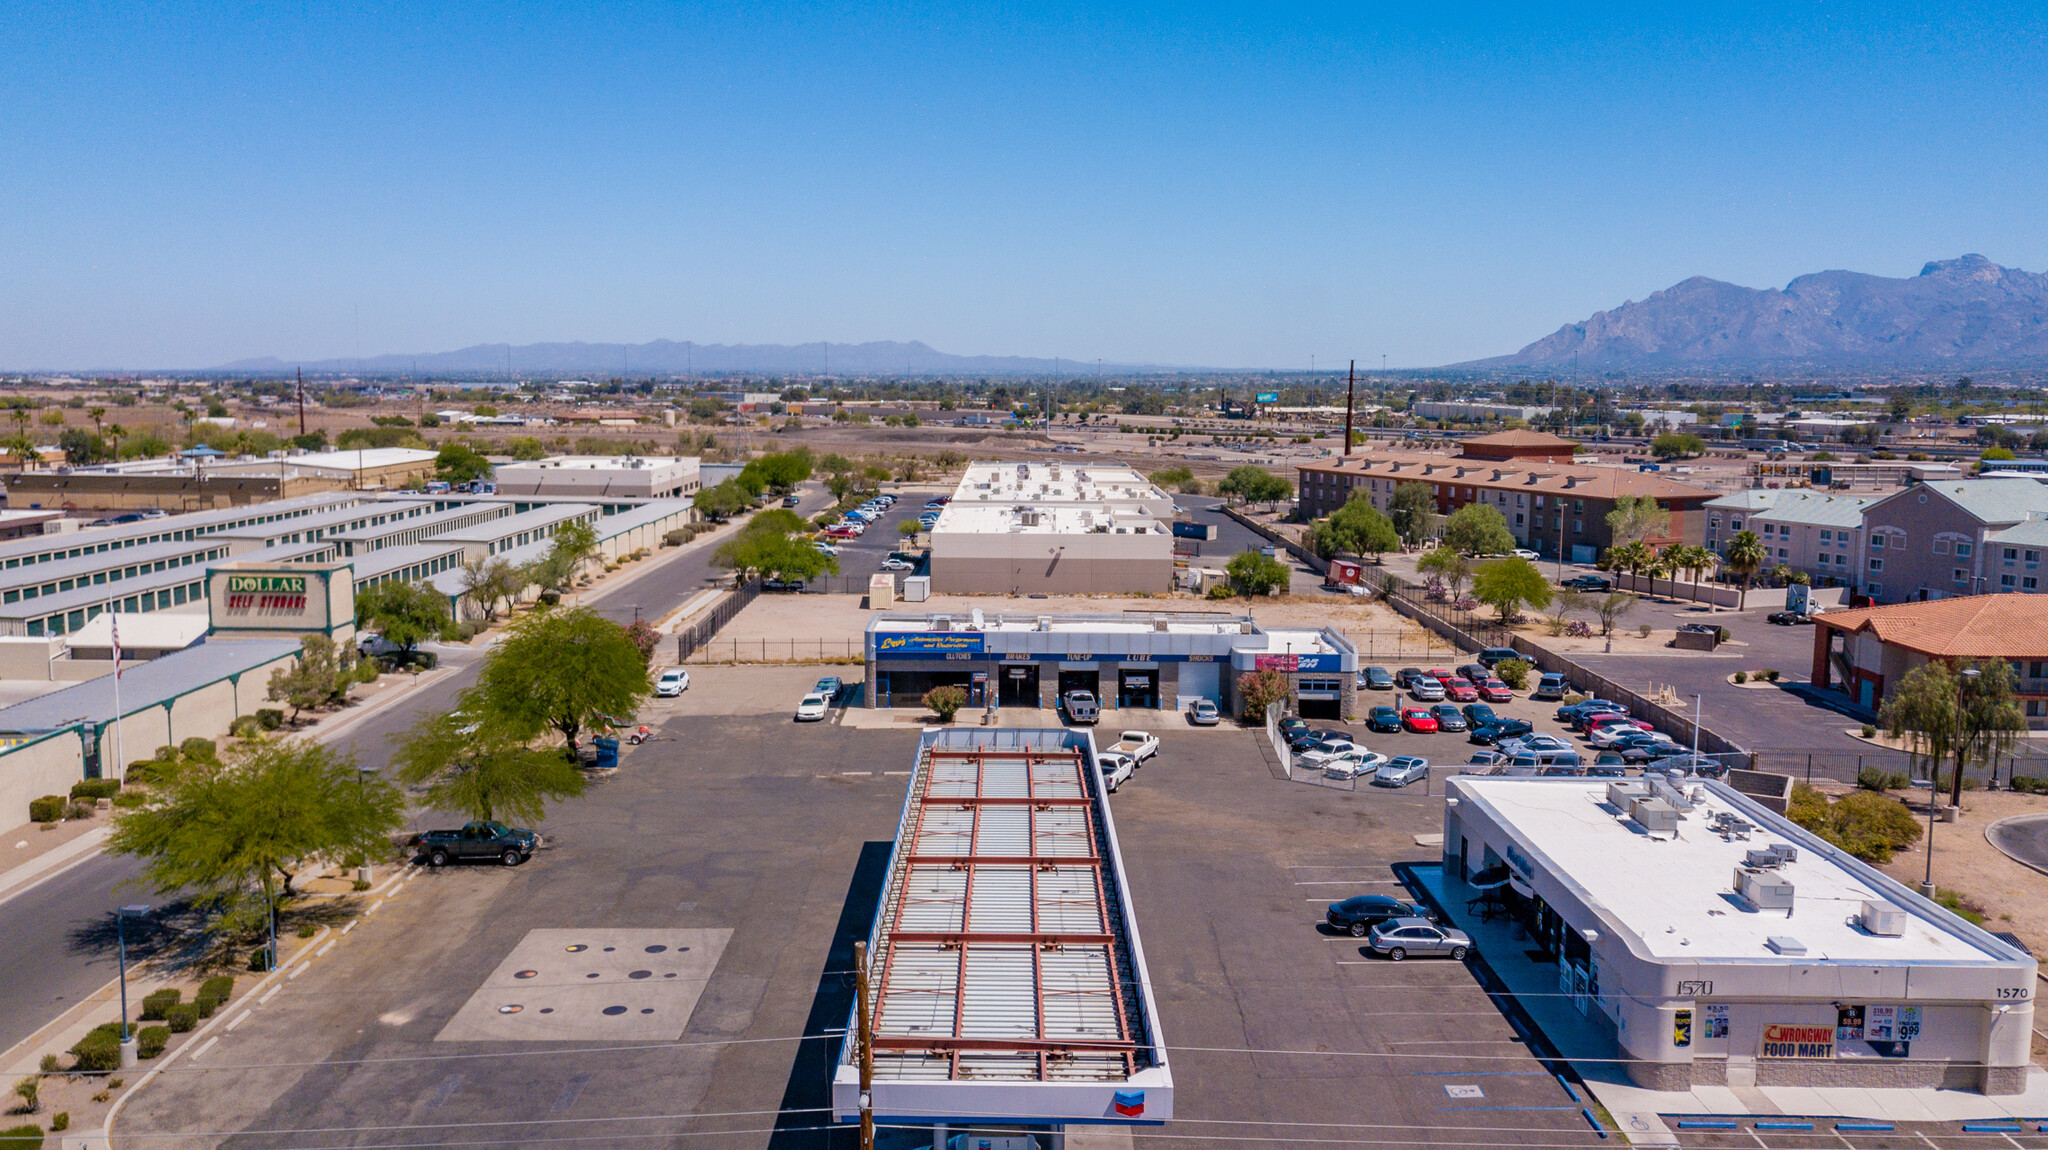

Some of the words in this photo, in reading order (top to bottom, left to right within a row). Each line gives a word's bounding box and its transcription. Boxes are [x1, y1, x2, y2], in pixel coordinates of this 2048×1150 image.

[231, 578, 304, 592] DOLLAR
[229, 595, 254, 608] SELF
[260, 595, 307, 609] STORAGE
[946, 652, 972, 660] CLUTCHES
[1005, 652, 1031, 660] BRAKES
[1066, 653, 1093, 661] TUNE-UP
[1126, 653, 1153, 661] LUBE
[1188, 654, 1214, 662] SHOCKS
[1677, 980, 1713, 995] 1570
[1997, 988, 2028, 998] 1570
[1780, 1028, 1834, 1043] WRONGWAY
[1763, 1043, 1796, 1057] FOOD
[1798, 1043, 1833, 1058] MART
